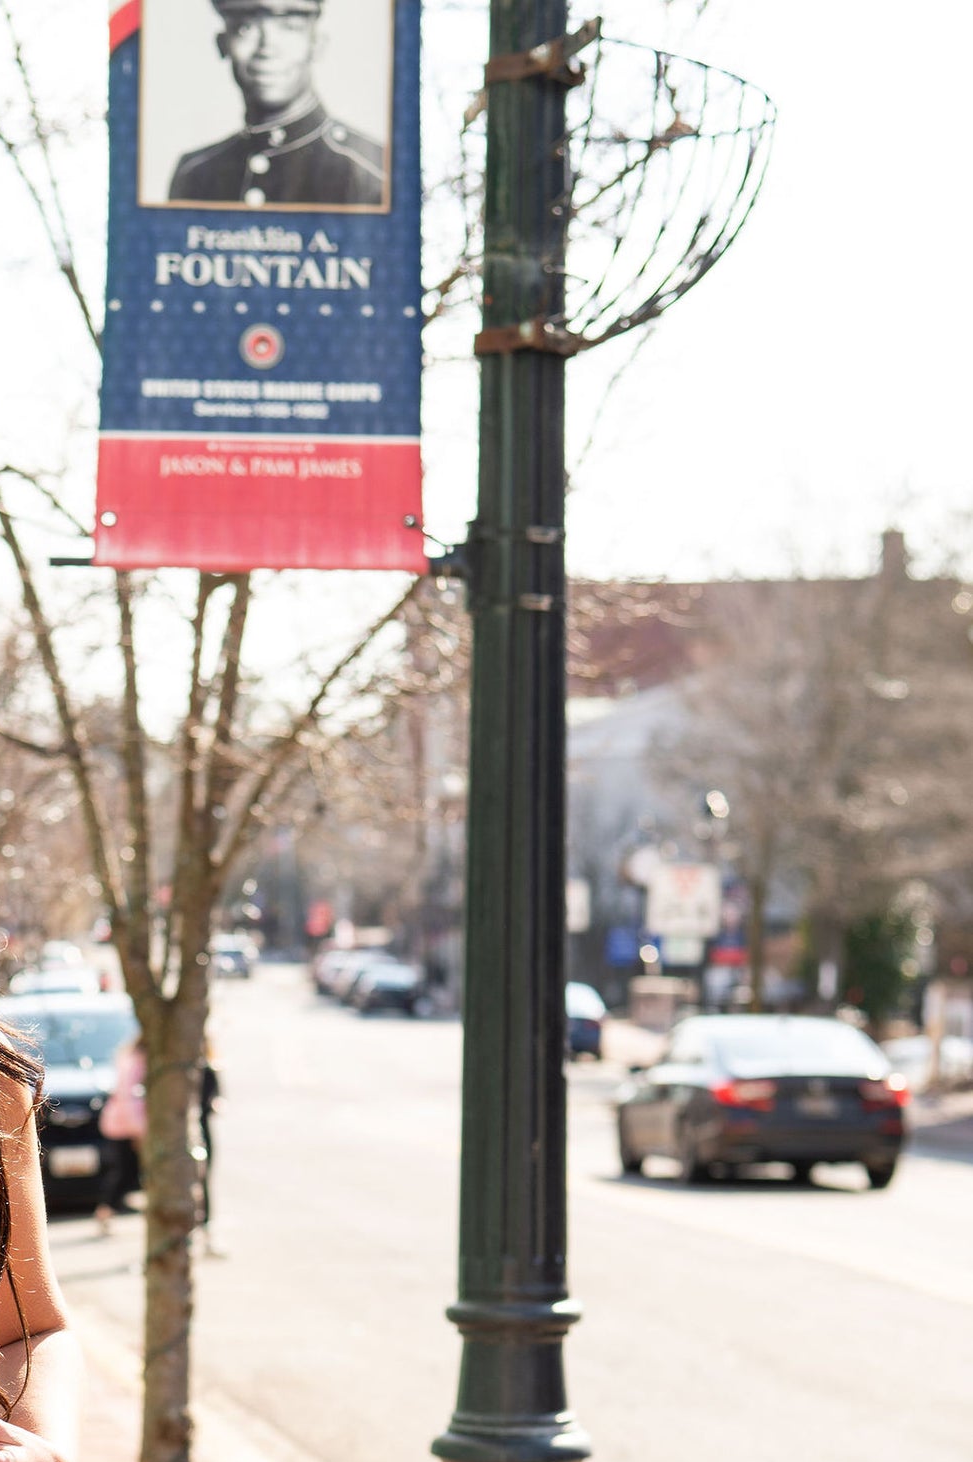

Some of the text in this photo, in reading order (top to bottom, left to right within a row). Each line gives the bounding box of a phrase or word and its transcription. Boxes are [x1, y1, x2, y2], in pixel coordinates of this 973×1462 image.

[188, 225, 338, 252] Franklin A.
[156, 253, 371, 290] FOUNTAIN
[143, 380, 199, 397] UNITED
[203, 381, 259, 399] STATES
[160, 455, 362, 480] JASON & PAM JAMES
